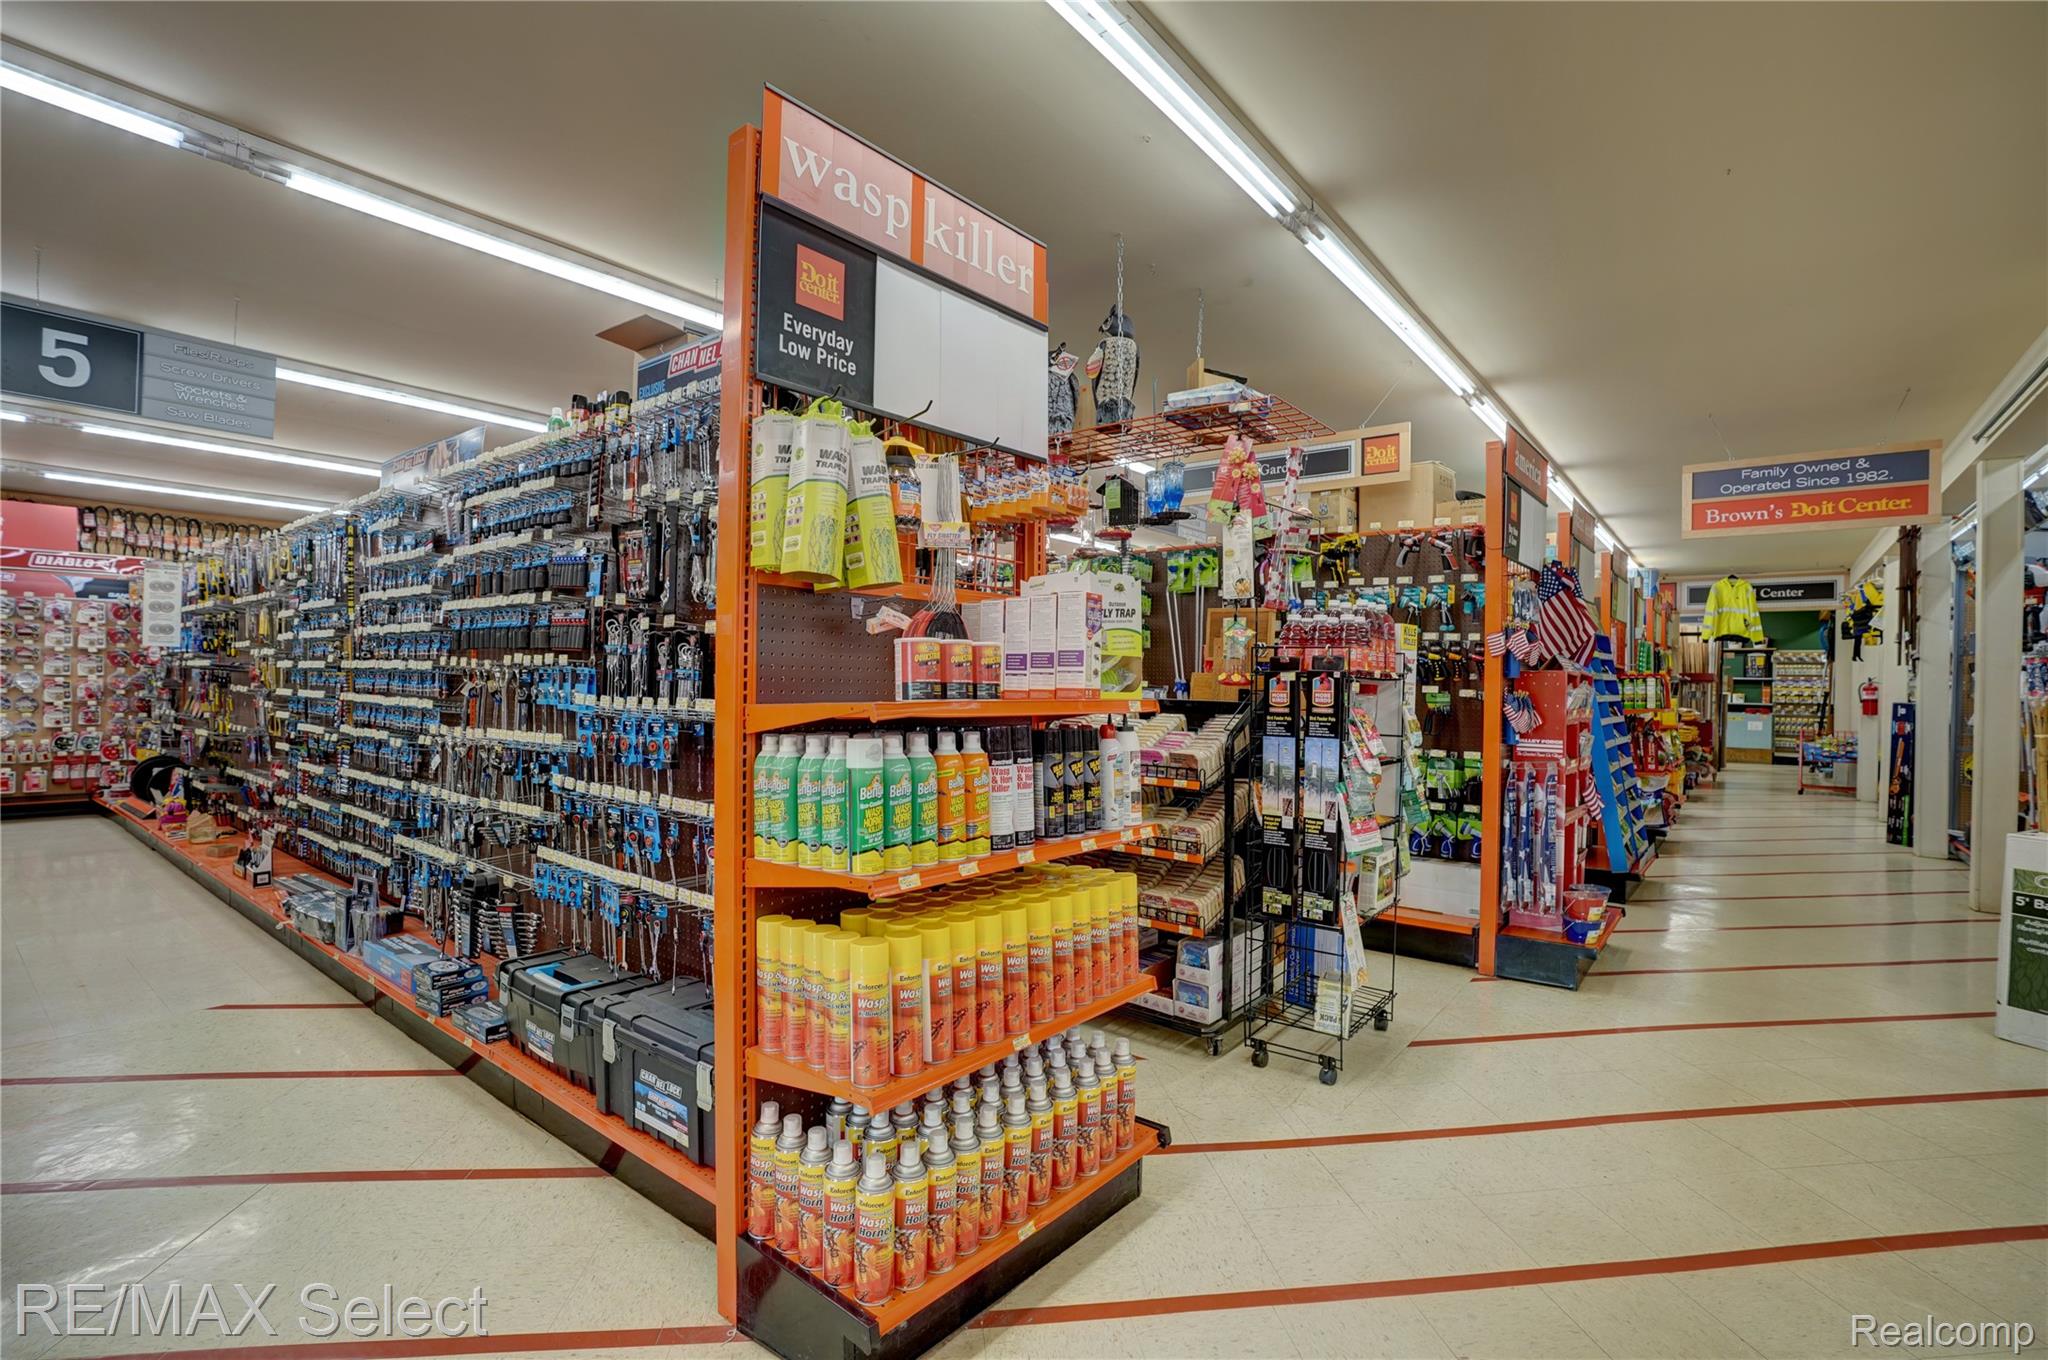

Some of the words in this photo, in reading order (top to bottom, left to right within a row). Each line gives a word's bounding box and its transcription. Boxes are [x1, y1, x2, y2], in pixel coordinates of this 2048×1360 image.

[784, 135, 910, 239] wasp
[924, 197, 1034, 296] killer
[783, 311, 854, 357] Everyday
[37, 327, 91, 388] 5
[779, 333, 811, 361] Low
[816, 346, 857, 376] Price
[160, 361, 208, 380] Screw
[212, 372, 262, 392] Drivers
[174, 382, 233, 402] Sockets
[236, 394, 248, 404] &
[176, 391, 246, 412] Wrenches
[166, 405, 199, 420] Saw
[204, 411, 252, 430] Blades
[1741, 464, 1788, 480] Family
[1793, 458, 1850, 476] Owned
[1855, 457, 1870, 469] &
[1720, 478, 1791, 496] Operated
[1796, 474, 1841, 488] Since
[1847, 469, 1894, 484] 1982.
[1705, 504, 1784, 525] Brown's
[35, 555, 95, 569] DIABLO
[1760, 587, 1804, 599] Center
[1115, 608, 1136, 619] TRAP
[991, 785, 1010, 793] Killer
[857, 983, 884, 991] Enforcer
[857, 998, 884, 1010] Wasp
[859, 1200, 885, 1208] Enforcer
[859, 1215, 887, 1227] Wasp
[859, 1226, 892, 1238] Hornet
